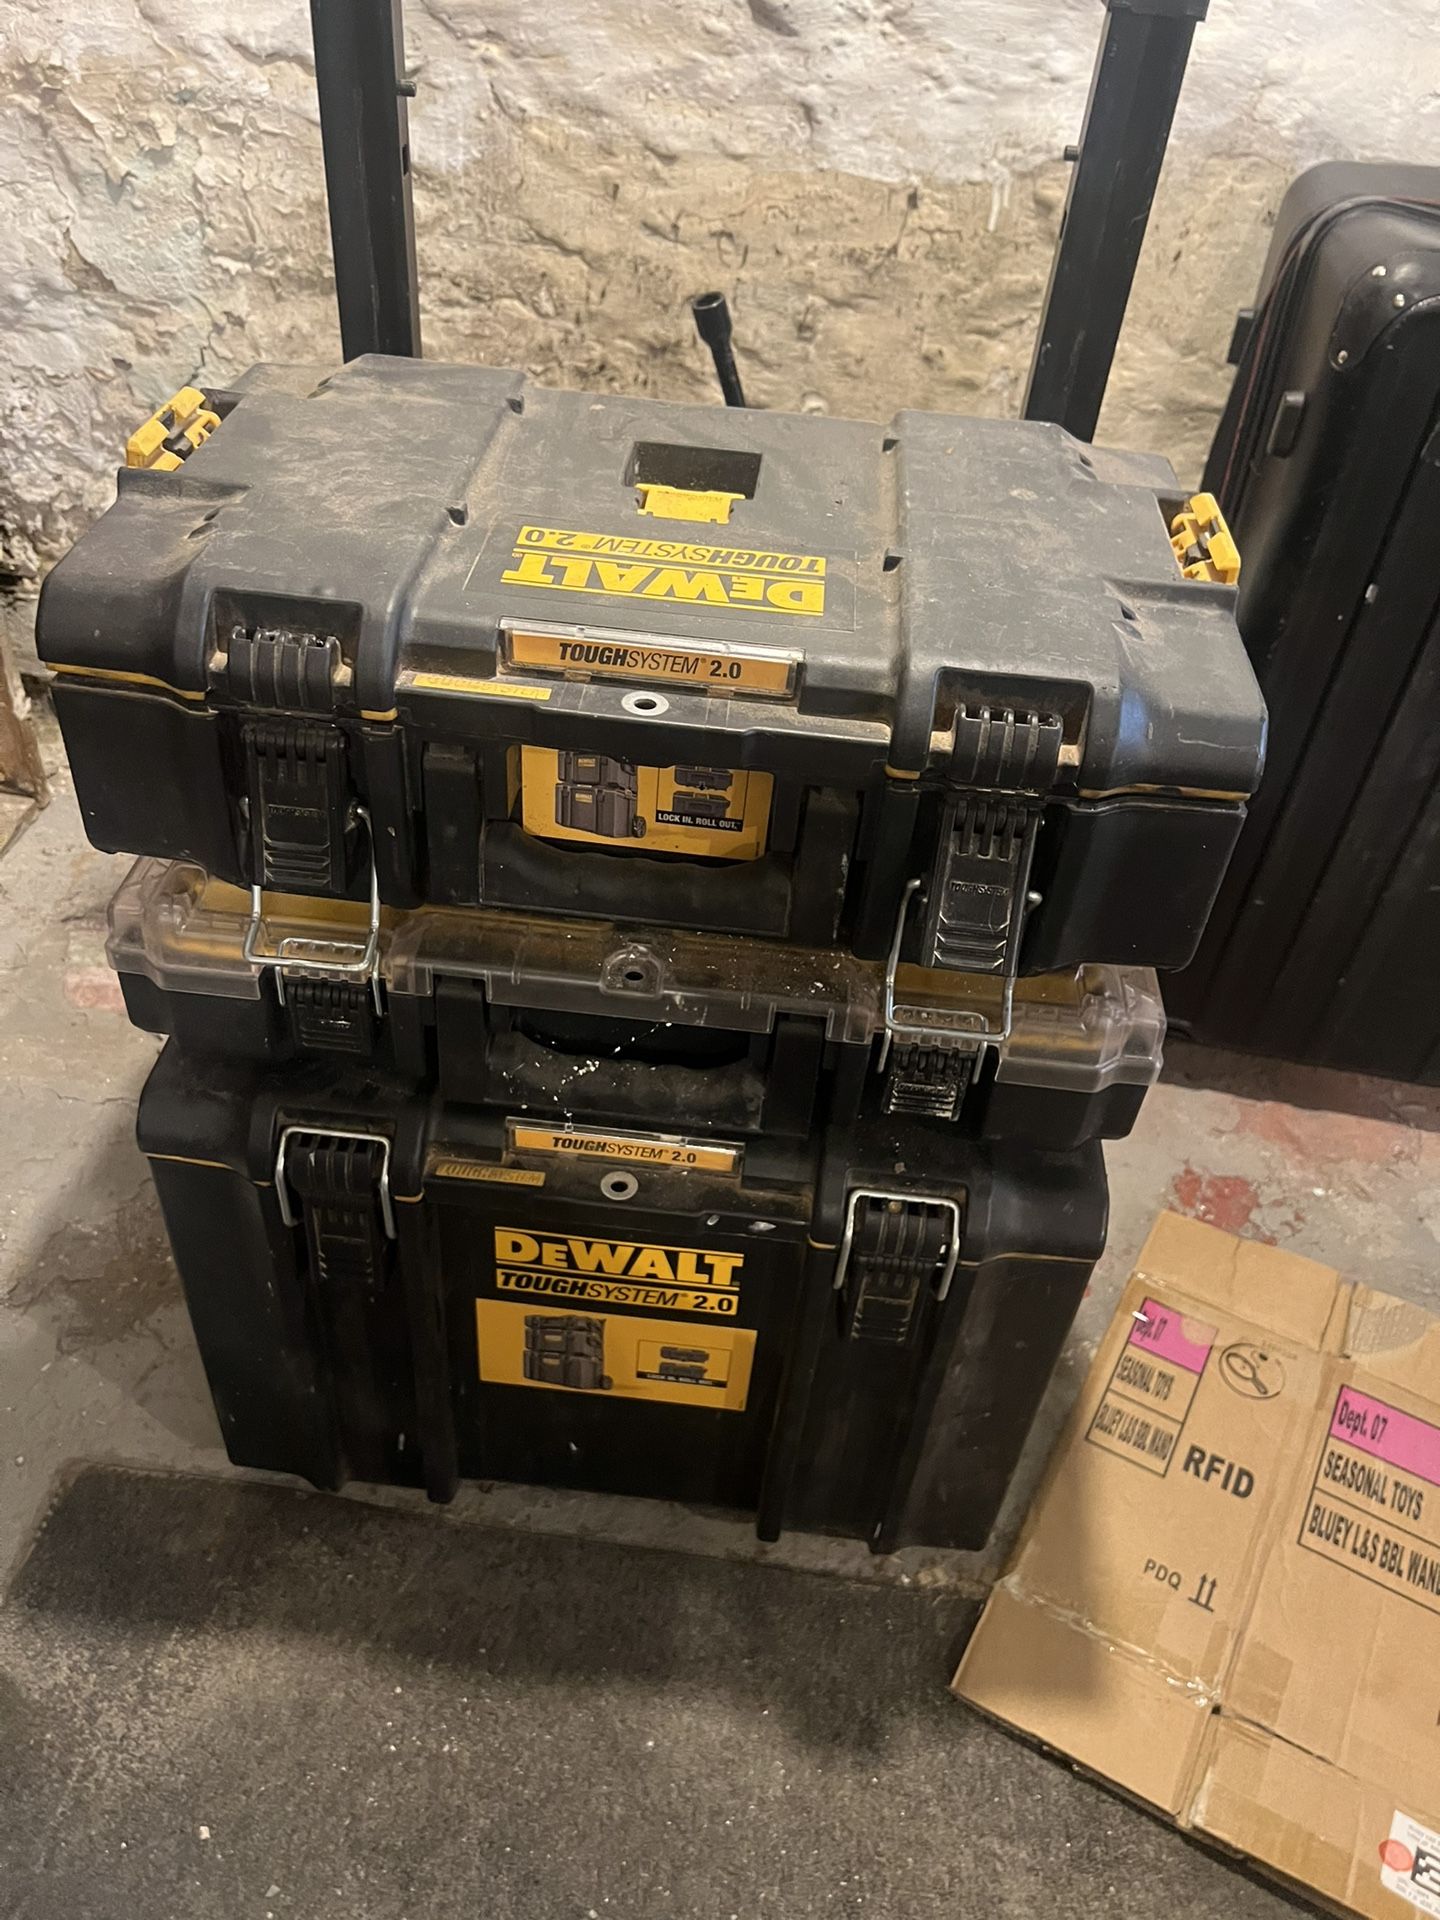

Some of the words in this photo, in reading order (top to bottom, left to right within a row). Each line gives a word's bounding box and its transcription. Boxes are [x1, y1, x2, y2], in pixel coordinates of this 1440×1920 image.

[525, 529, 577, 547] 2.0
[710, 660, 742, 680] 2.0
[658, 813, 680, 823] LOCK
[696, 817, 716, 827] ROLL
[672, 1151, 697, 1164] 2.0
[495, 1230, 744, 1285] DEWALT
[693, 1294, 733, 1312] 2.0
[1337, 1401, 1368, 1439] Dept.
[1370, 1414, 1388, 1443] 07
[1183, 1443, 1255, 1499] RFID
[1324, 1450, 1388, 1505] SEASONAL
[1390, 1480, 1424, 1521] TOYS
[1308, 1505, 1354, 1549] BLUEY
[1351, 1524, 1381, 1564] L&S
[1378, 1538, 1405, 1578] BBL
[1143, 1558, 1182, 1591] PDQ
